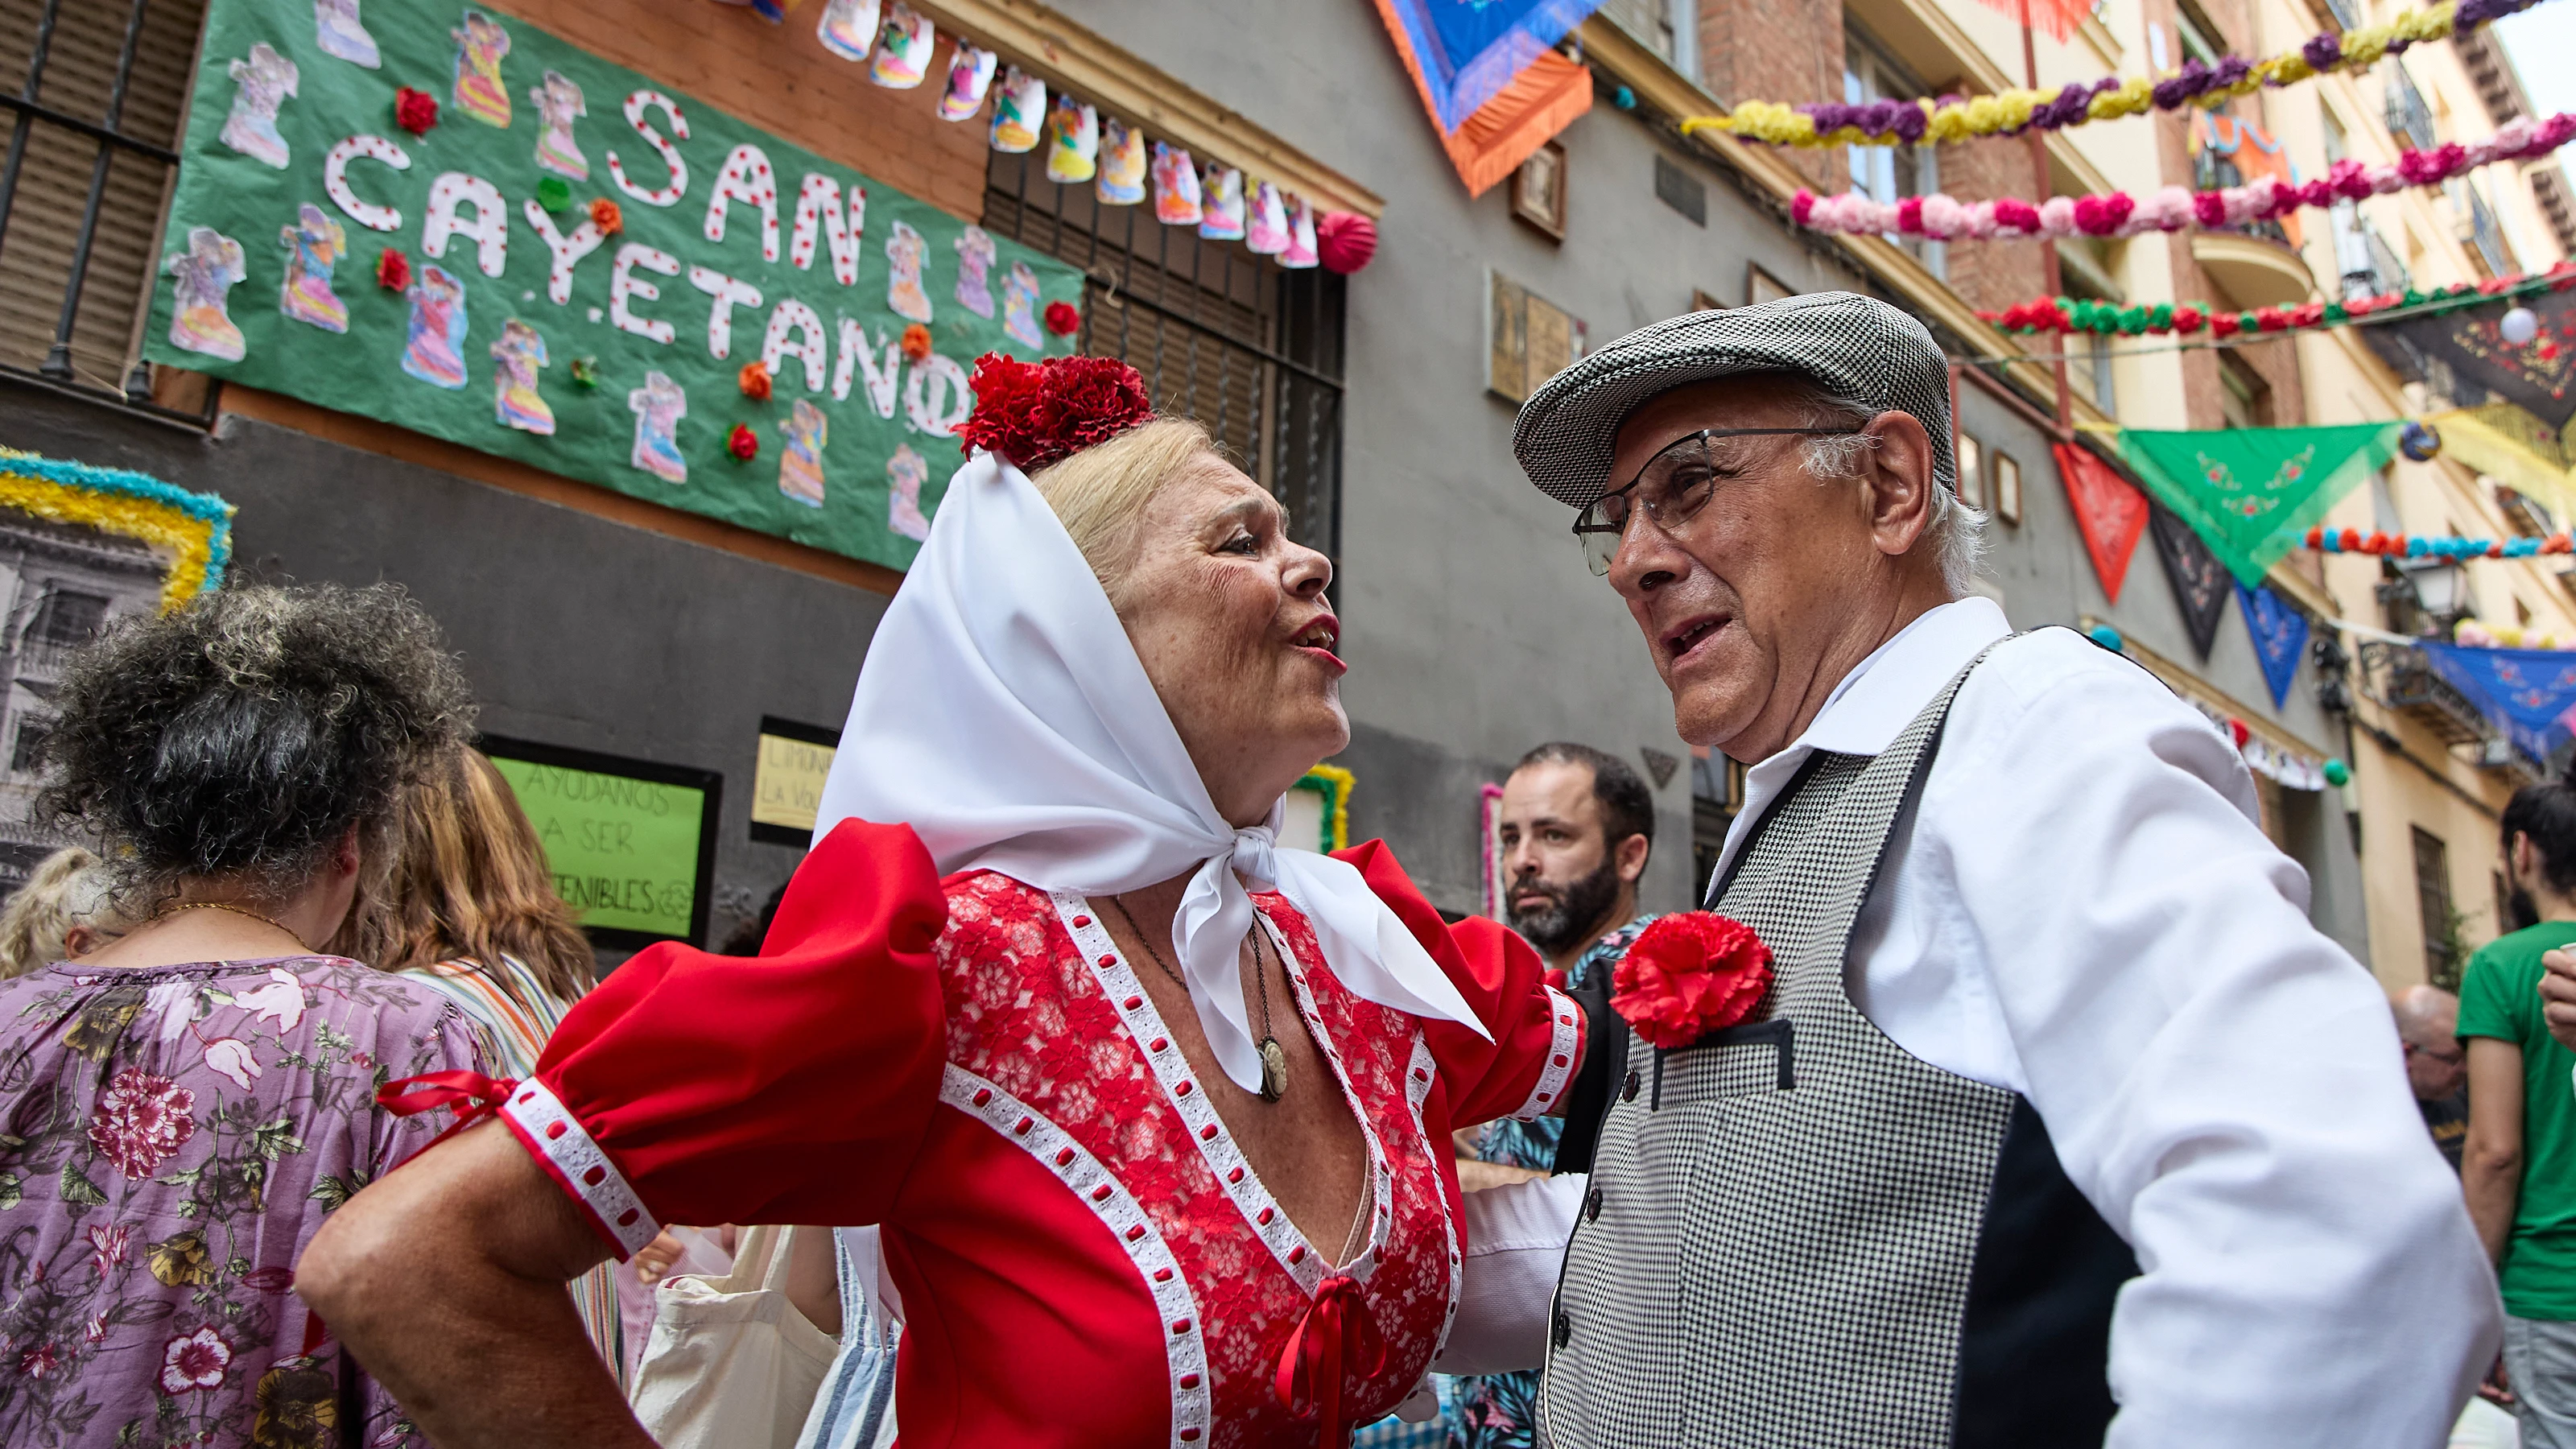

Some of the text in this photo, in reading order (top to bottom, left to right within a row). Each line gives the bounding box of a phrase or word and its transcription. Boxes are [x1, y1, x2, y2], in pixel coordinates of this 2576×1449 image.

[606, 89, 866, 287] SAN
[324, 134, 971, 439] CAYETANO
[524, 764, 670, 817] AYUDANOS
[543, 816, 634, 856] A SER
